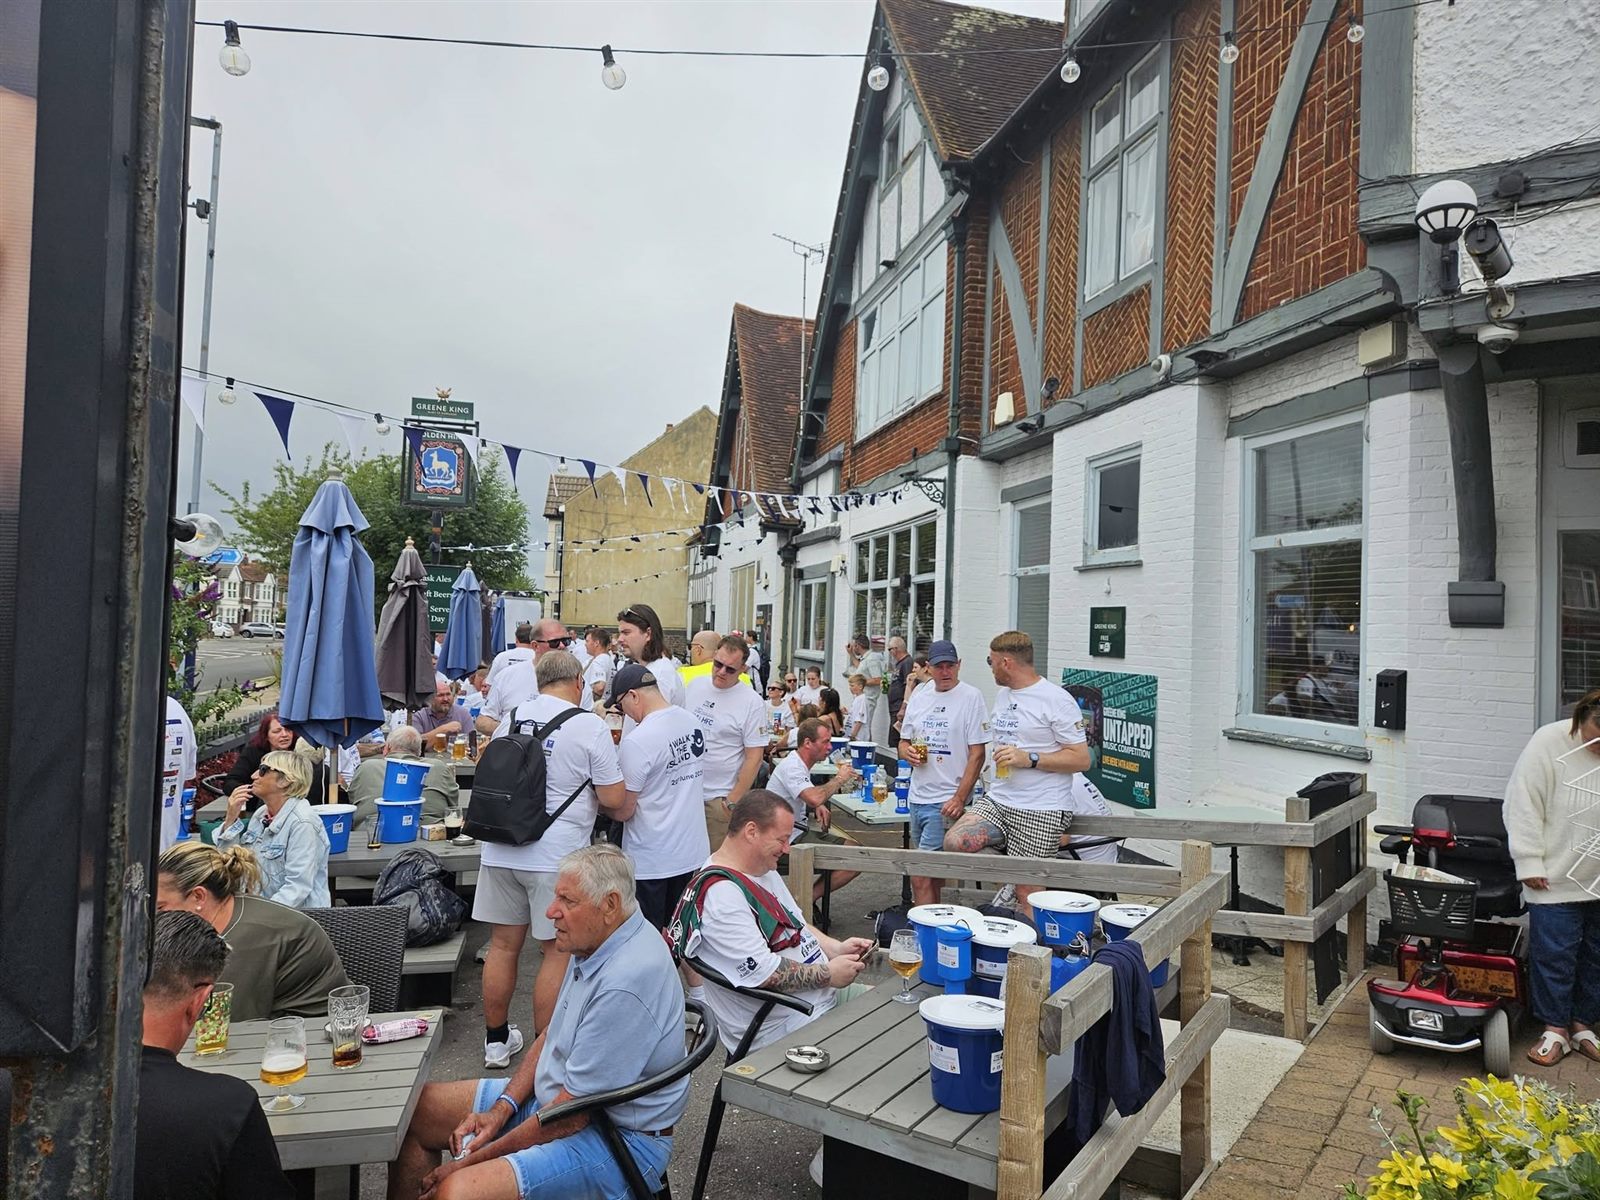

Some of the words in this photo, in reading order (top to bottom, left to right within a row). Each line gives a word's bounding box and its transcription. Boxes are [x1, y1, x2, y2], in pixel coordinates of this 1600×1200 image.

[415, 403, 447, 412] GREENE
[449, 406, 469, 414] KING
[422, 431, 445, 439] OLDEN
[436, 574, 452, 582] Ales
[433, 590, 452, 598] Beer
[429, 604, 450, 613] Serve
[431, 615, 446, 624] Day
[1102, 718, 1153, 750] UNTAPPED
[672, 734, 691, 748] WALK
[1102, 741, 1118, 752] MUSIC
[1118, 744, 1151, 759] COMPETITION
